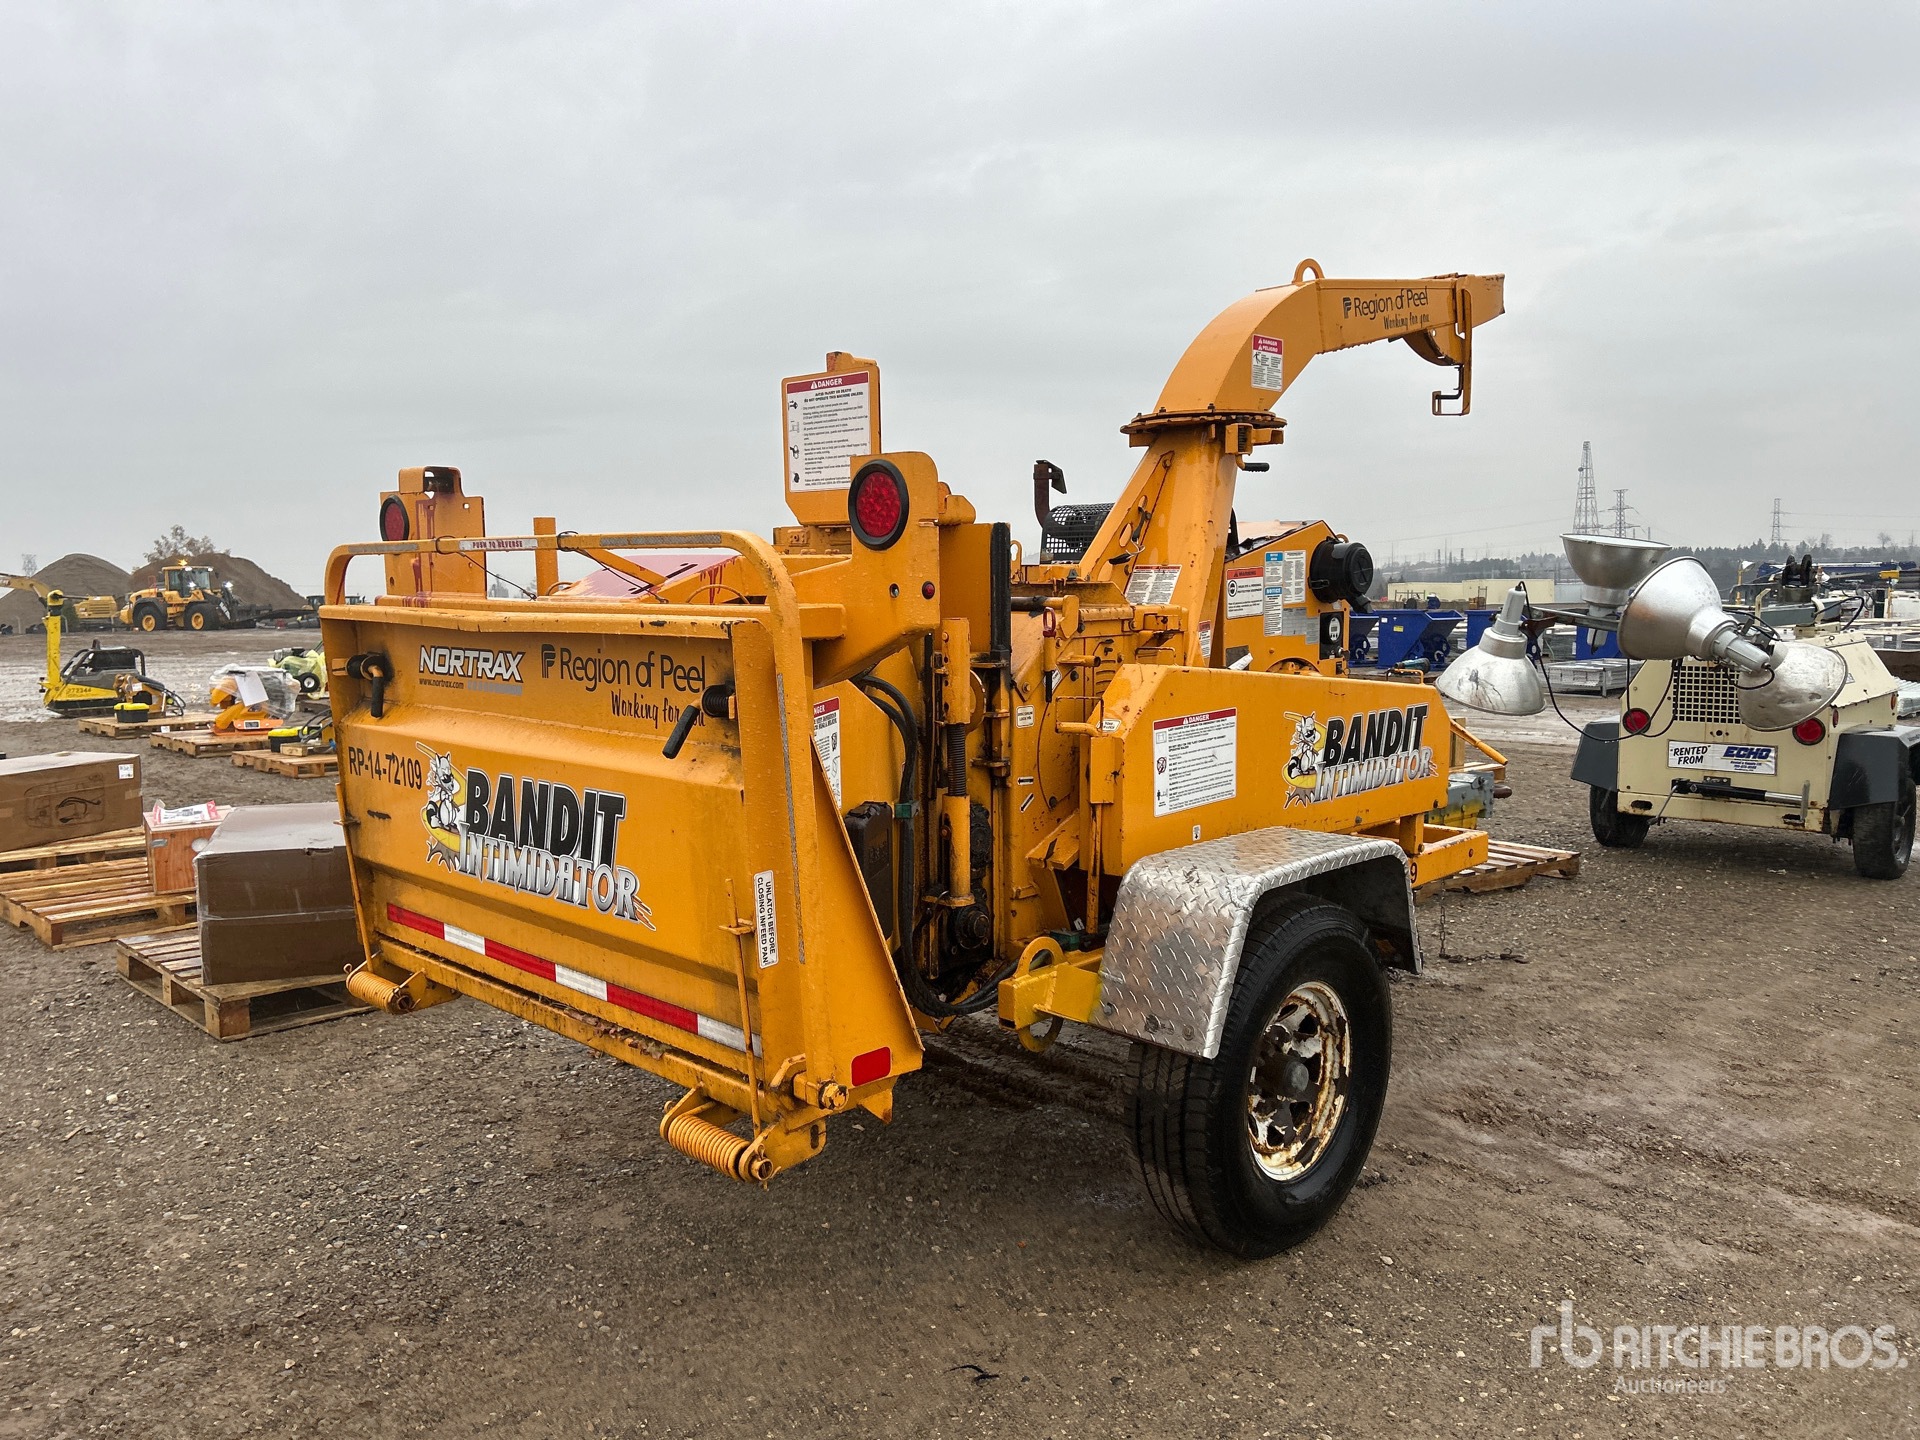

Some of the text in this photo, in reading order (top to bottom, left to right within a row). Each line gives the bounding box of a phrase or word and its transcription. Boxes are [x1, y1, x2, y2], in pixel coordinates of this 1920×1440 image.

[1353, 286, 1429, 320] Region of Peel
[1383, 313, 1409, 331] Working
[817, 378, 843, 388] DANGER
[419, 644, 526, 683] NORTRAX
[560, 647, 630, 692] Region
[636, 651, 655, 687] of
[660, 655, 706, 693] Peel
[419, 678, 464, 690] www.nortrax.com
[611, 689, 659, 729] Working
[662, 697, 679, 722] for
[1188, 714, 1210, 723] DANGER
[1323, 703, 1429, 767] BANDIT
[1722, 746, 1772, 760] ECHO
[348, 746, 423, 790] RP-14-72109
[1312, 748, 1433, 803] INTIMIDATOR
[1677, 755, 1704, 765] FROM
[465, 768, 626, 868] BANDIT
[458, 821, 640, 924] INTIMIDATOR
[757, 877, 766, 913] CLOSING
[765, 881, 776, 954] UNLATCH BEFORE
